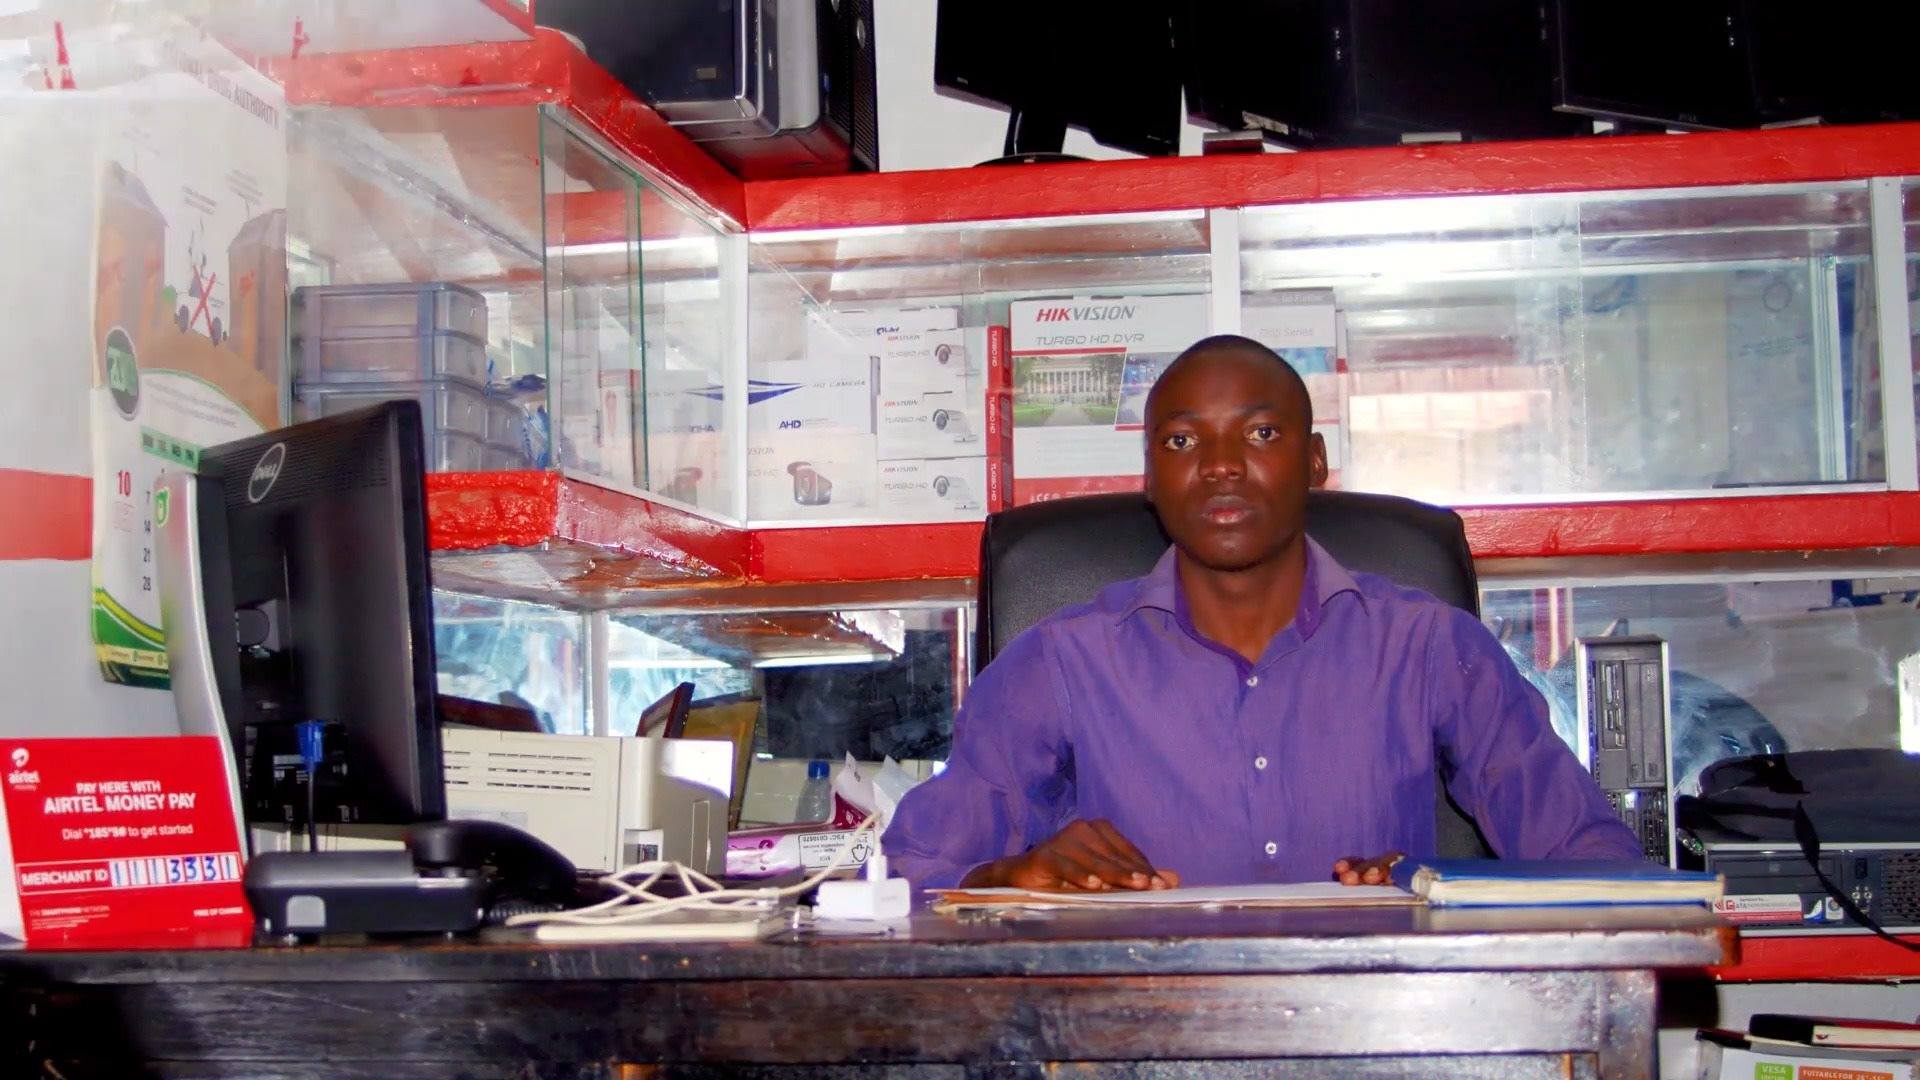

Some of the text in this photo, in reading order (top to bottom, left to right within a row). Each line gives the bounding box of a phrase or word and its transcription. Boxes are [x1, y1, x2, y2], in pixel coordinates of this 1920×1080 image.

[233, 82, 280, 130] AUTHORITY
[1036, 304, 1136, 322] HIKVISION
[1037, 333, 1145, 346] TURBO HD DVR
[779, 420, 802, 430] AHD
[117, 471, 132, 496] 10
[8, 770, 40, 784] airtel
[76, 780, 161, 794] PAY HERE WITH
[44, 792, 197, 814] AIRTEL MONEY PAY
[62, 828, 82, 840] Dial
[128, 825, 140, 837] to
[141, 825, 158, 839] get
[159, 823, 194, 836] started
[21, 868, 109, 886] MERCHANT ID
[1762, 1065, 1787, 1074] VESA
